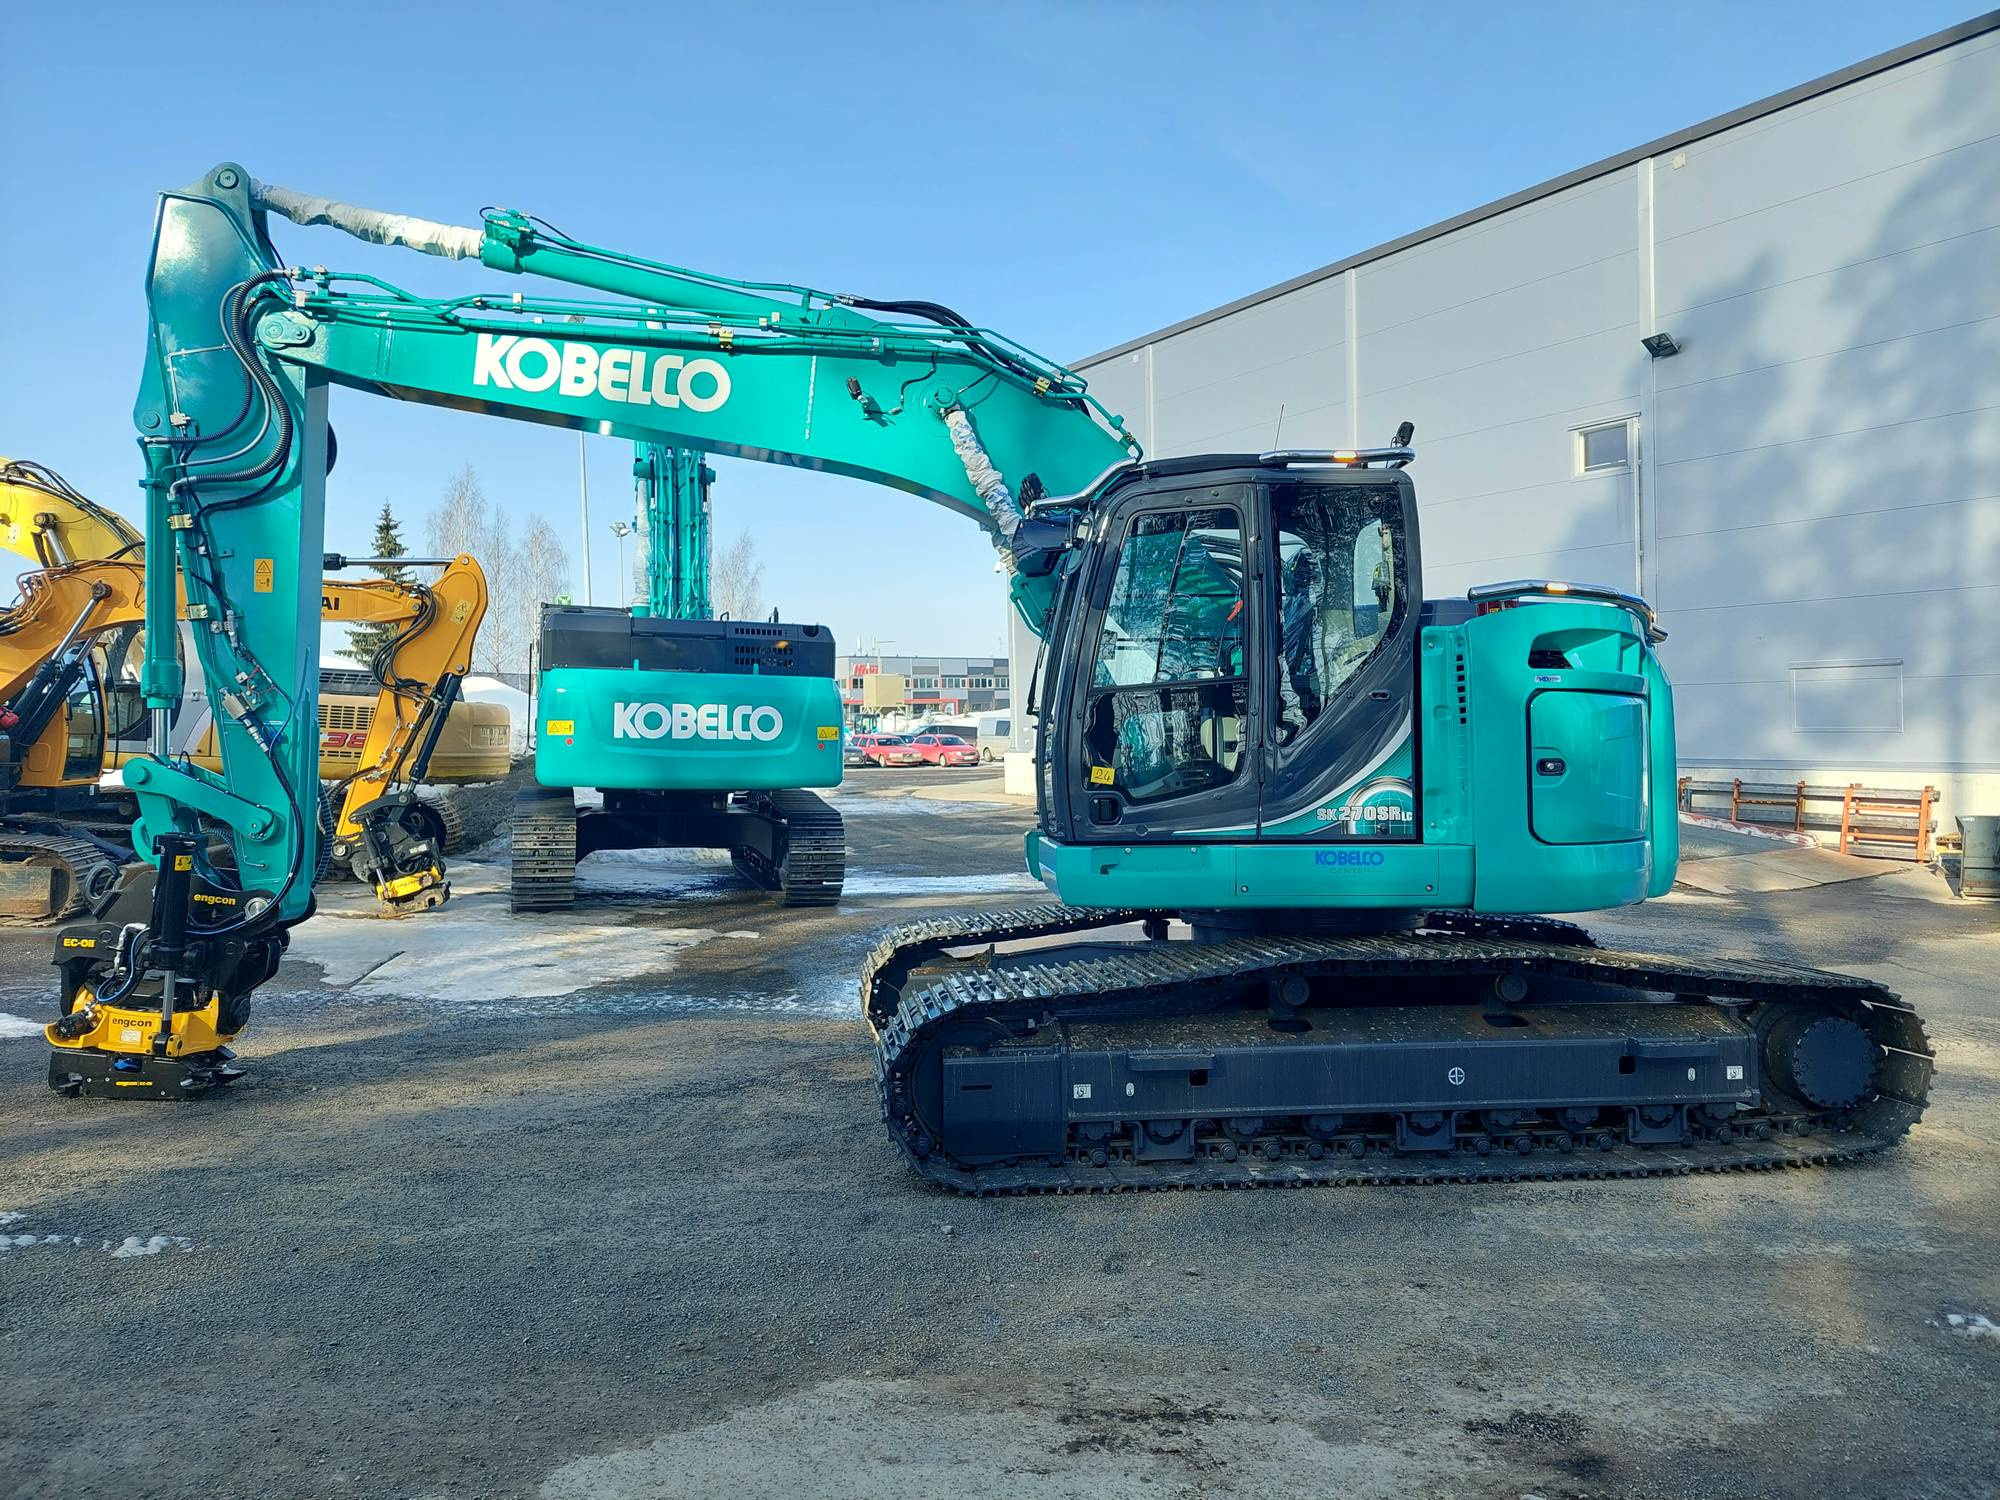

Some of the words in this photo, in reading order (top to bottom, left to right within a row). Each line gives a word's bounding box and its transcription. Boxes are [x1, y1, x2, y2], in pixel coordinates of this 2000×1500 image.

[473, 333, 731, 413] KOBELCO
[613, 702, 783, 742] KOBELCO
[1315, 850, 1385, 867] KOBELCO
[193, 893, 236, 906] engcon
[112, 1017, 152, 1028] engcon
